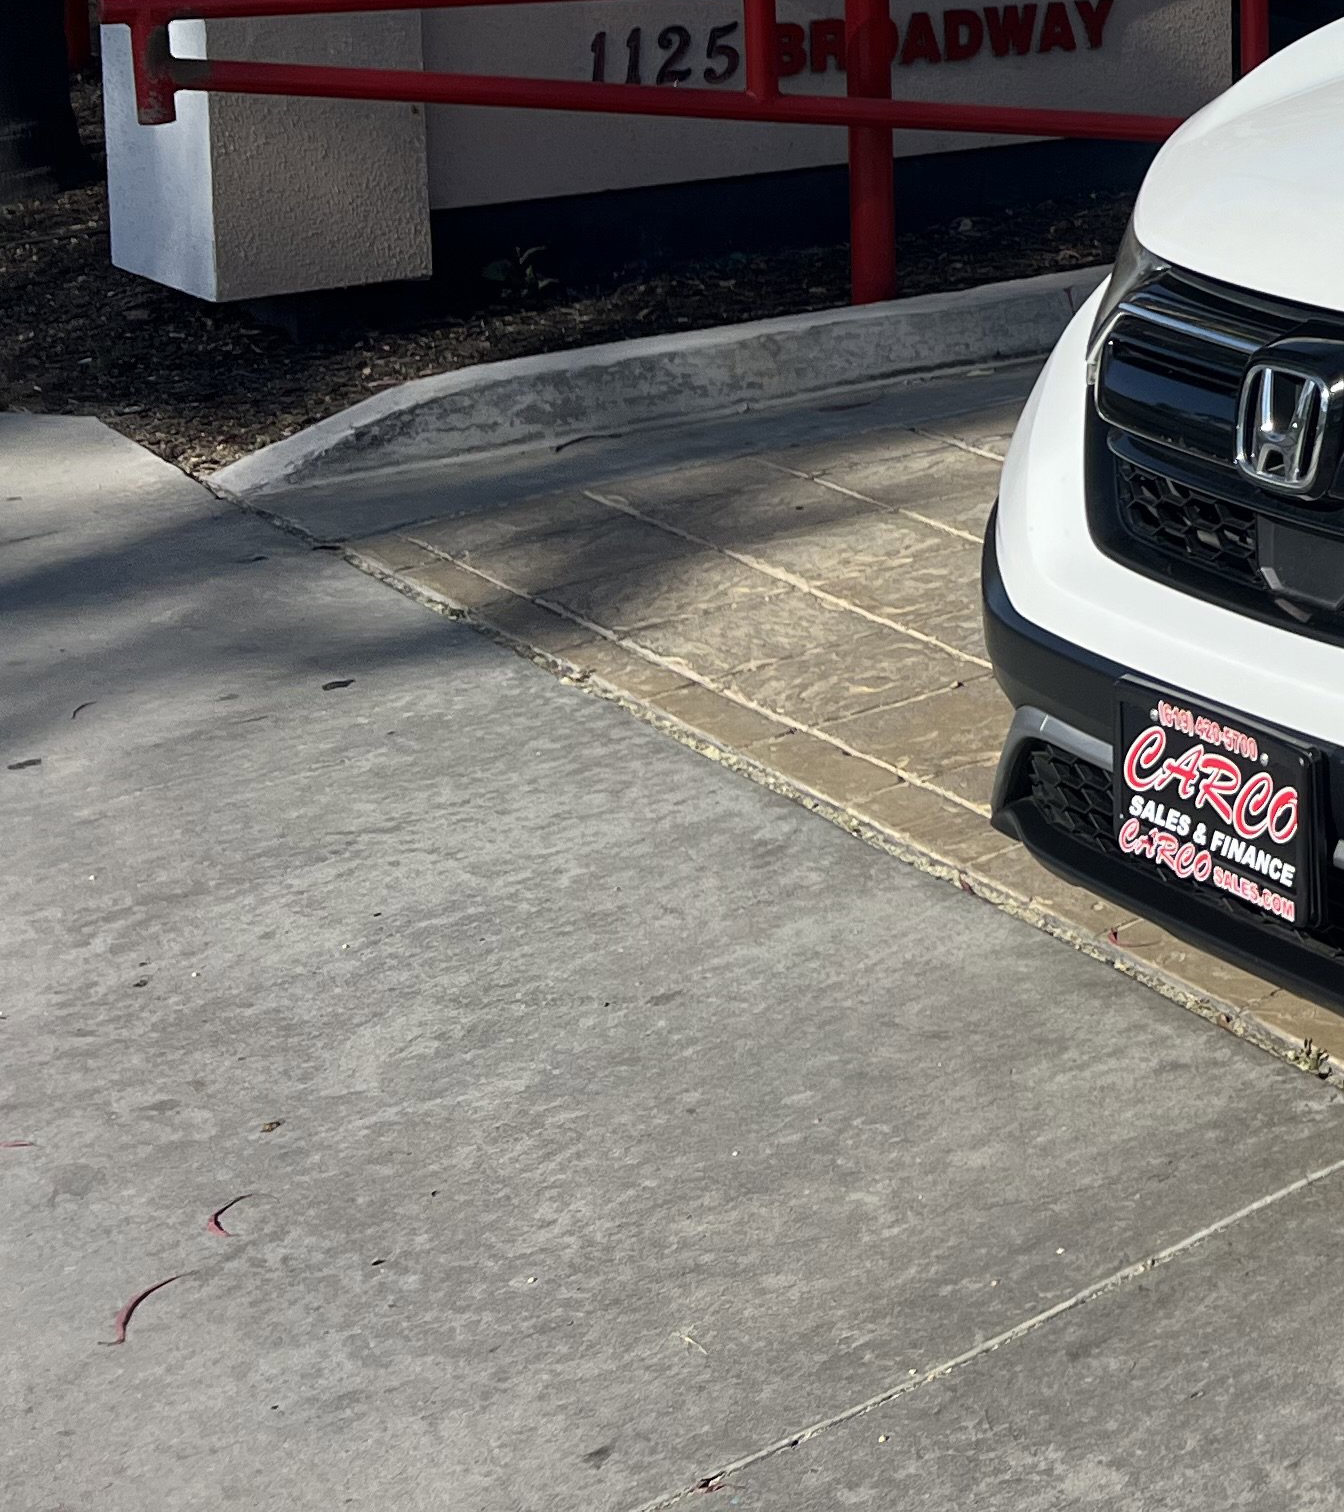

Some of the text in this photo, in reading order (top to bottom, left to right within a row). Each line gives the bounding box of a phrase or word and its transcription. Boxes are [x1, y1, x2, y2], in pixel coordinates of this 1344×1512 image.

[590, 20, 741, 86] 1125
[1123, 725, 1298, 844] CARCO
[1118, 818, 1295, 923] CARCO SALES.COM
[1129, 795, 1296, 888] SALES & FINANCE
